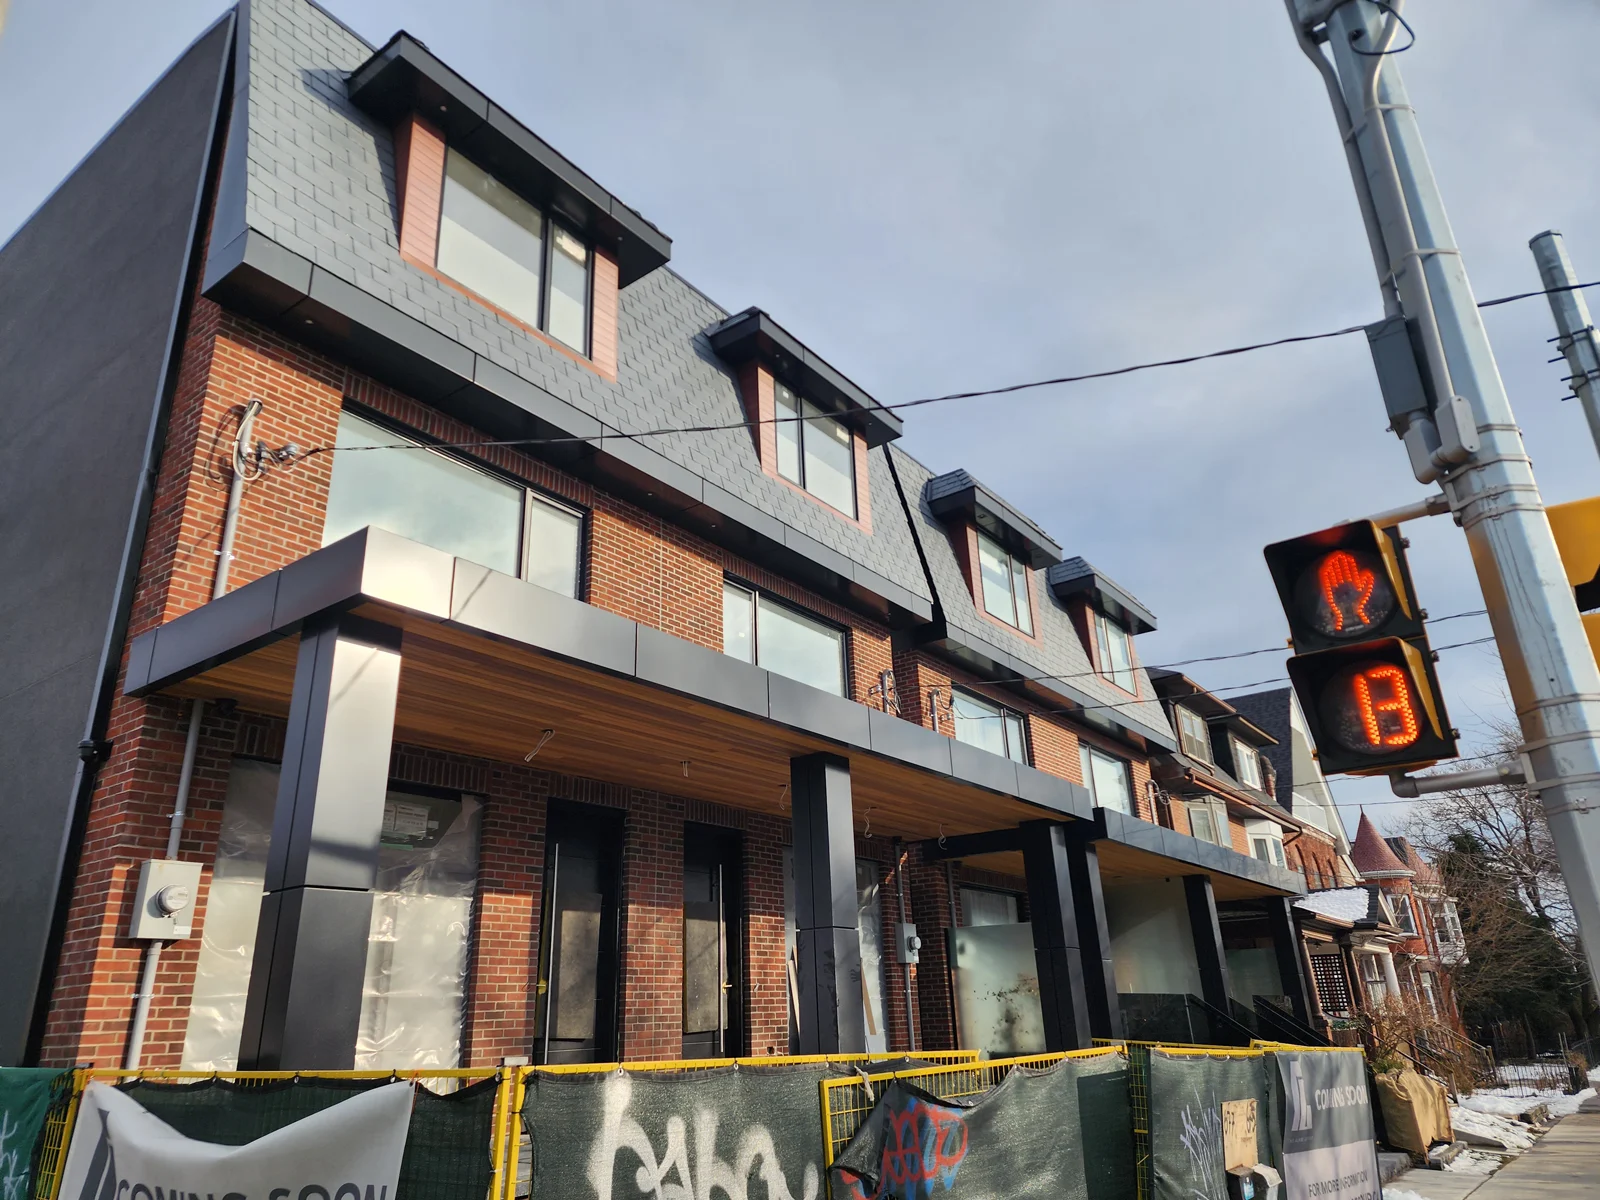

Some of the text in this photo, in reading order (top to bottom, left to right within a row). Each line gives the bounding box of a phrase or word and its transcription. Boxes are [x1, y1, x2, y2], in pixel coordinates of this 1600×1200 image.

[1354, 666, 1417, 745] 13
[1345, 1084, 1368, 1106] SOON
[1308, 1182, 1321, 1197] FOR
[1320, 1178, 1339, 1195] MORE
